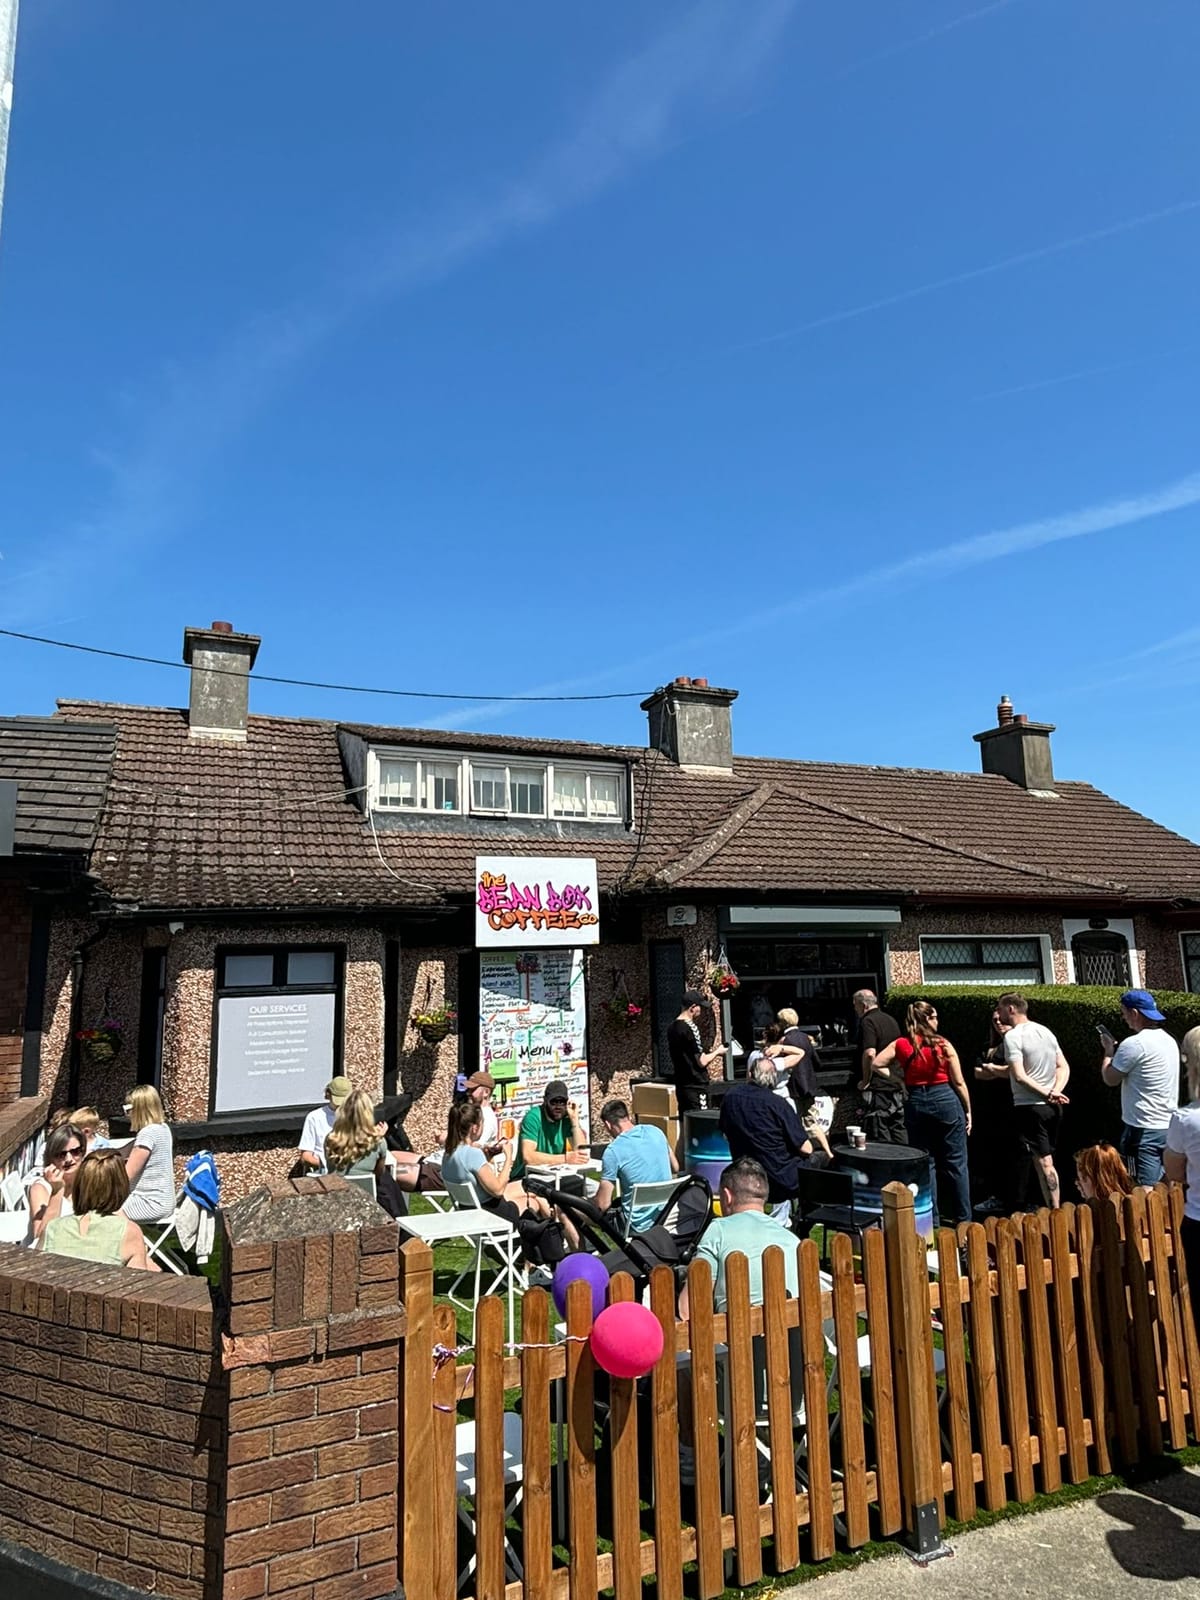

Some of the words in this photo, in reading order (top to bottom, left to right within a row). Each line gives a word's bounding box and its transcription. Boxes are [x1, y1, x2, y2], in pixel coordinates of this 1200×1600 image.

[476, 881, 542, 914] BEAN
[546, 881, 592, 912] BOX
[488, 908, 583, 931] COFFEE
[249, 1005, 268, 1014] OUR
[270, 1004, 307, 1013] SERVICES
[484, 1047, 513, 1062] Acai
[518, 1045, 553, 1059] Menu
